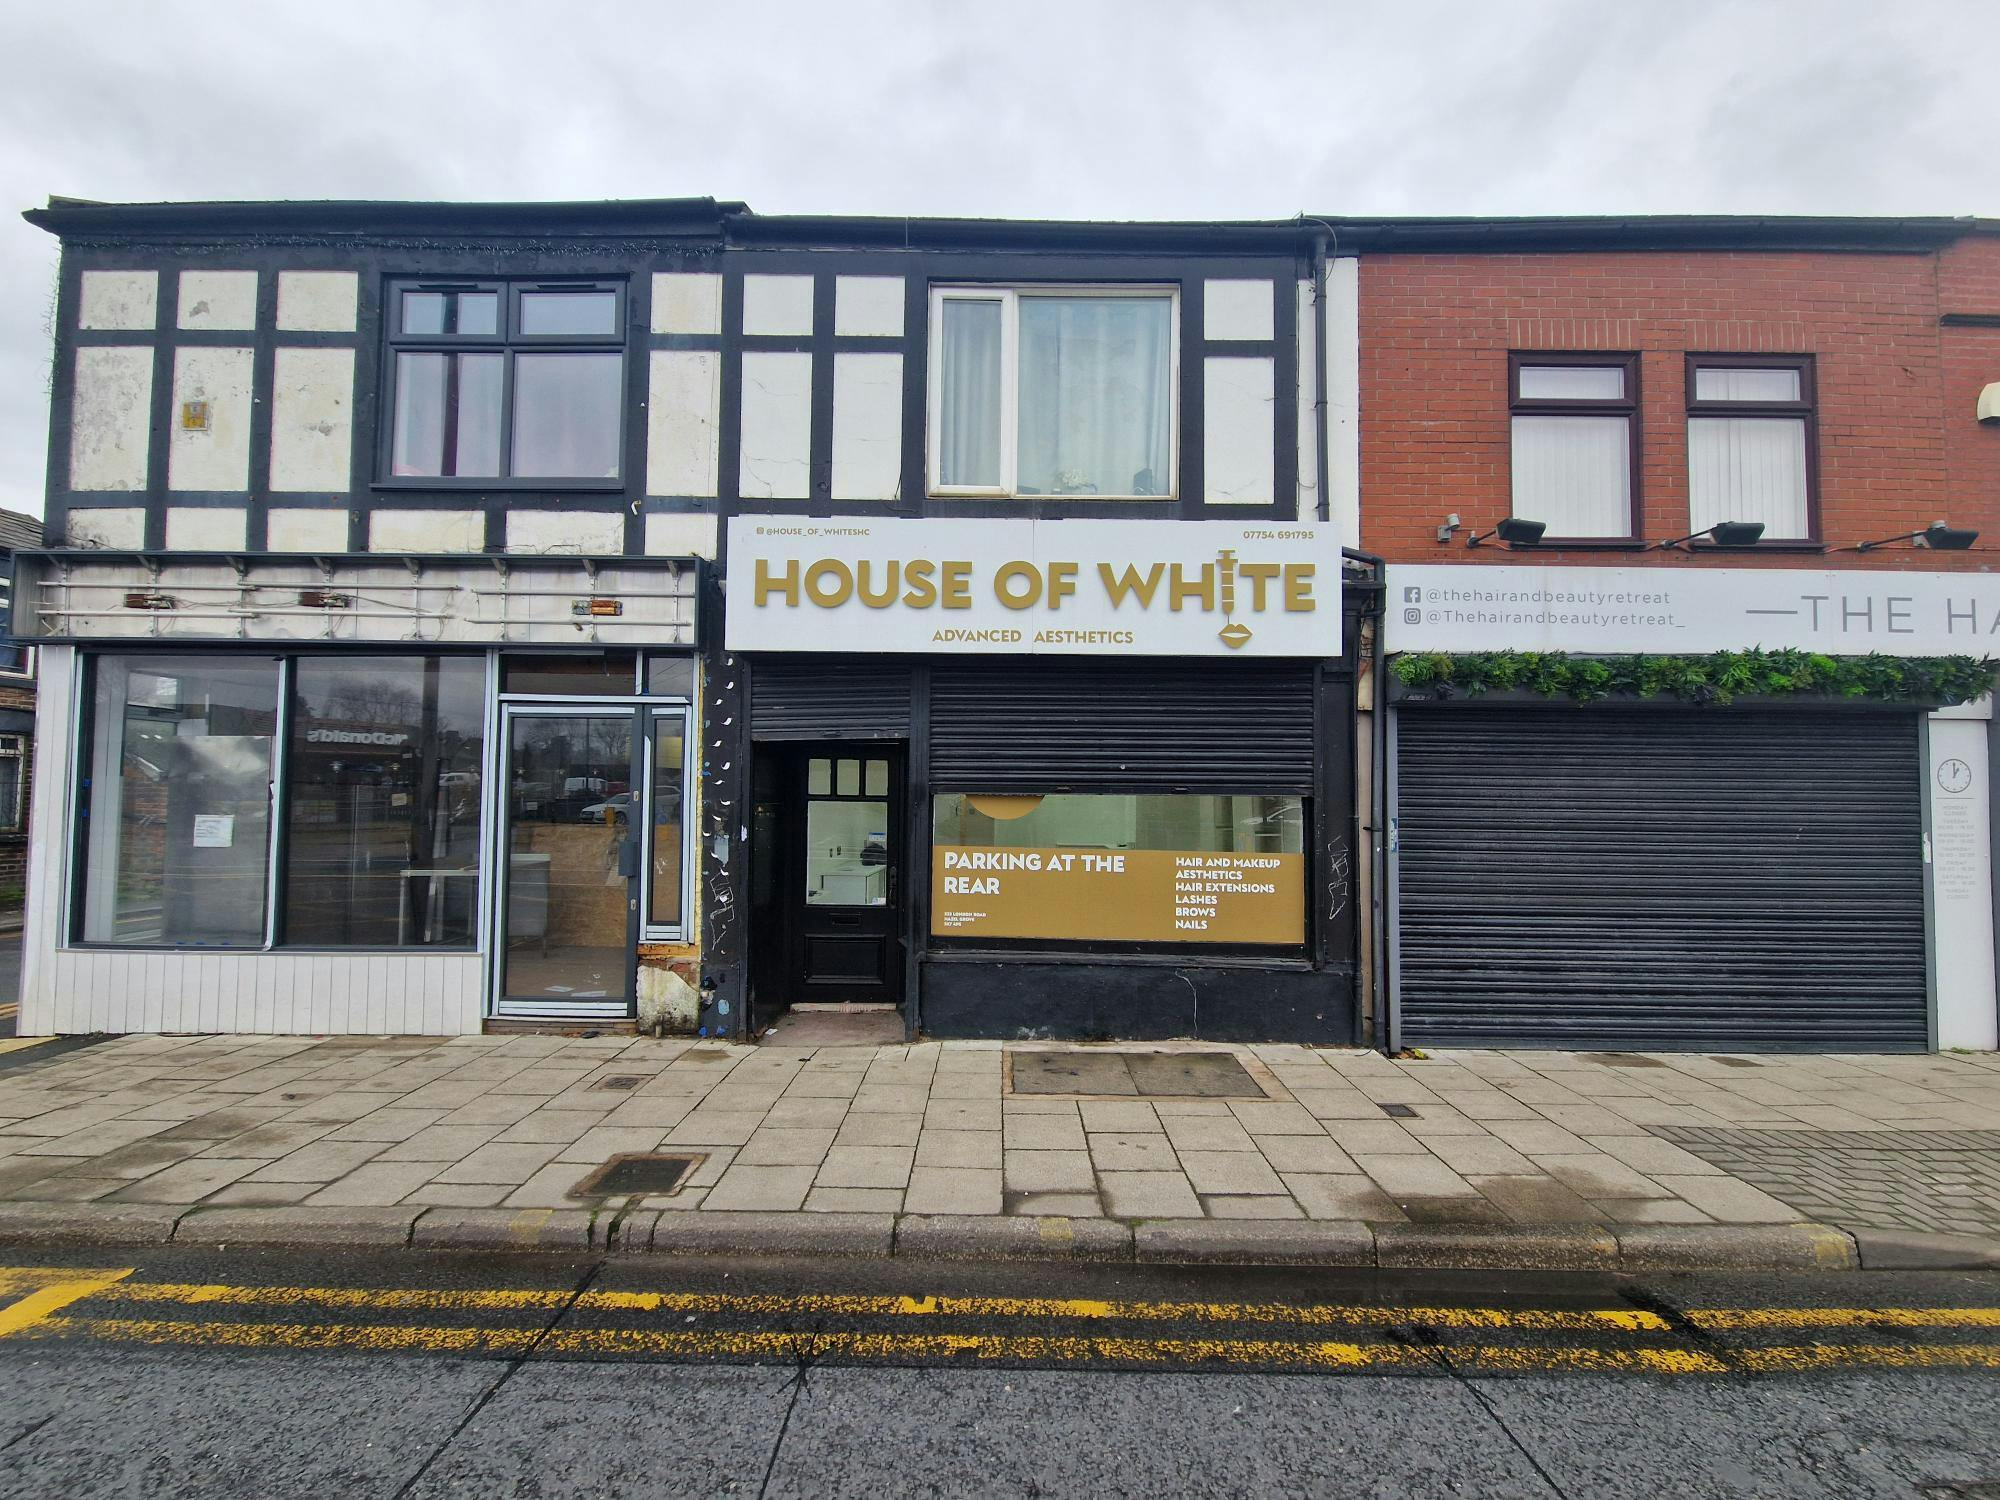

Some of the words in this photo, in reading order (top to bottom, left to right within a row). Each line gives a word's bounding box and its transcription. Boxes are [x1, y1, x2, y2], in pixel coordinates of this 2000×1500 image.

[766, 527, 870, 537] @HOUSE_OF_WHITESHC
[1243, 530, 1276, 540] 07754
[1278, 530, 1314, 541] 691795
[755, 559, 972, 610] HOUSE
[994, 561, 1078, 610] OF
[1097, 551, 1316, 614] WHITE
[1426, 589, 1670, 606] @thehairandbeautyretreat
[1426, 609, 1686, 628] @Thehairandbeautyretreat_
[1801, 595, 1915, 634] THE
[932, 629, 1022, 643] ADVANCED
[1034, 630, 1135, 645] AESTHETICS
[944, 851, 1042, 871] PARKING
[1047, 855, 1075, 872] AT
[1081, 855, 1125, 873] THE
[1176, 857, 1203, 867] HAIR
[1206, 858, 1230, 868] AND
[1233, 859, 1281, 869] MAKEUP
[1176, 869, 1243, 881] AESTHETICS
[944, 876, 1000, 895] REAR
[1176, 882, 1203, 892] HAIR
[1205, 883, 1275, 894] EXTENSIONS
[1176, 894, 1218, 905] LASHES
[1176, 906, 1216, 918] BROWS
[1176, 919, 1208, 930] NAILS
